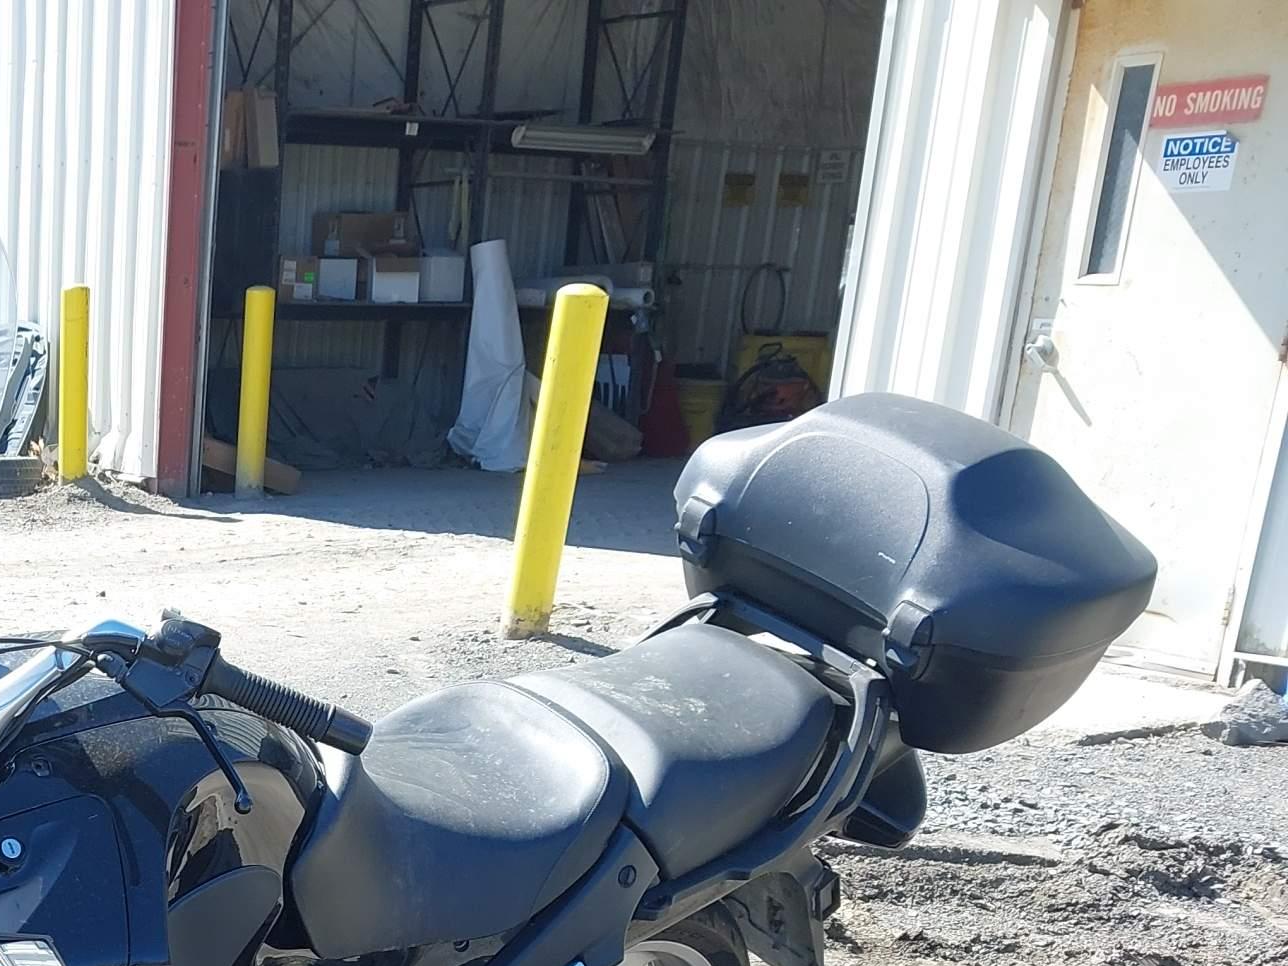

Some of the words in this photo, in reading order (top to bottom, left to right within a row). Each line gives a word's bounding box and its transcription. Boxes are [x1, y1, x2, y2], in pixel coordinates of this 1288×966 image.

[1153, 94, 1177, 118] NO
[1183, 86, 1265, 115] SMOKING
[1166, 136, 1232, 156] NOTICE
[1163, 155, 1230, 172] EMPLOYEES
[1178, 171, 1209, 185] ONLY
